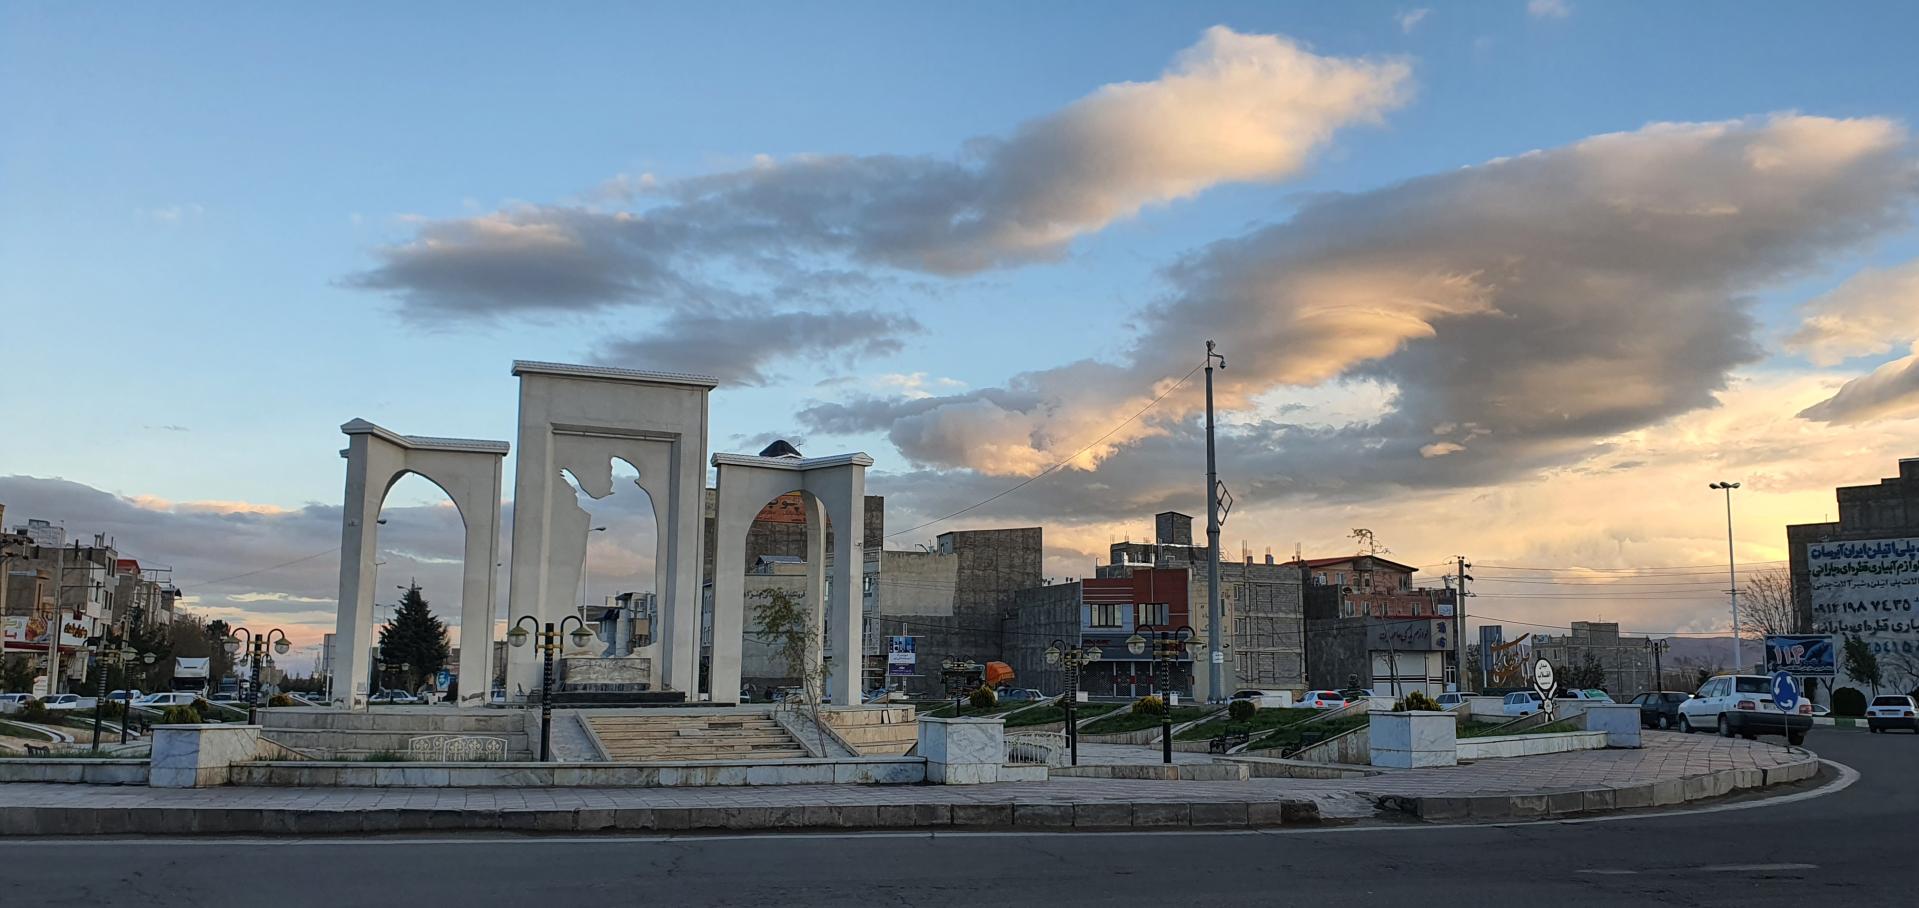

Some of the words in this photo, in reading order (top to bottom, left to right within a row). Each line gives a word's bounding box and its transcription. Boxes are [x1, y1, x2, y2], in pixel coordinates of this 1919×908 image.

[1844, 543, 1867, 558] ایران
[1867, 541, 1896, 559] اتیلن
[1895, 540, 1916, 560] پلی
[1869, 560, 1897, 574] آبیاری
